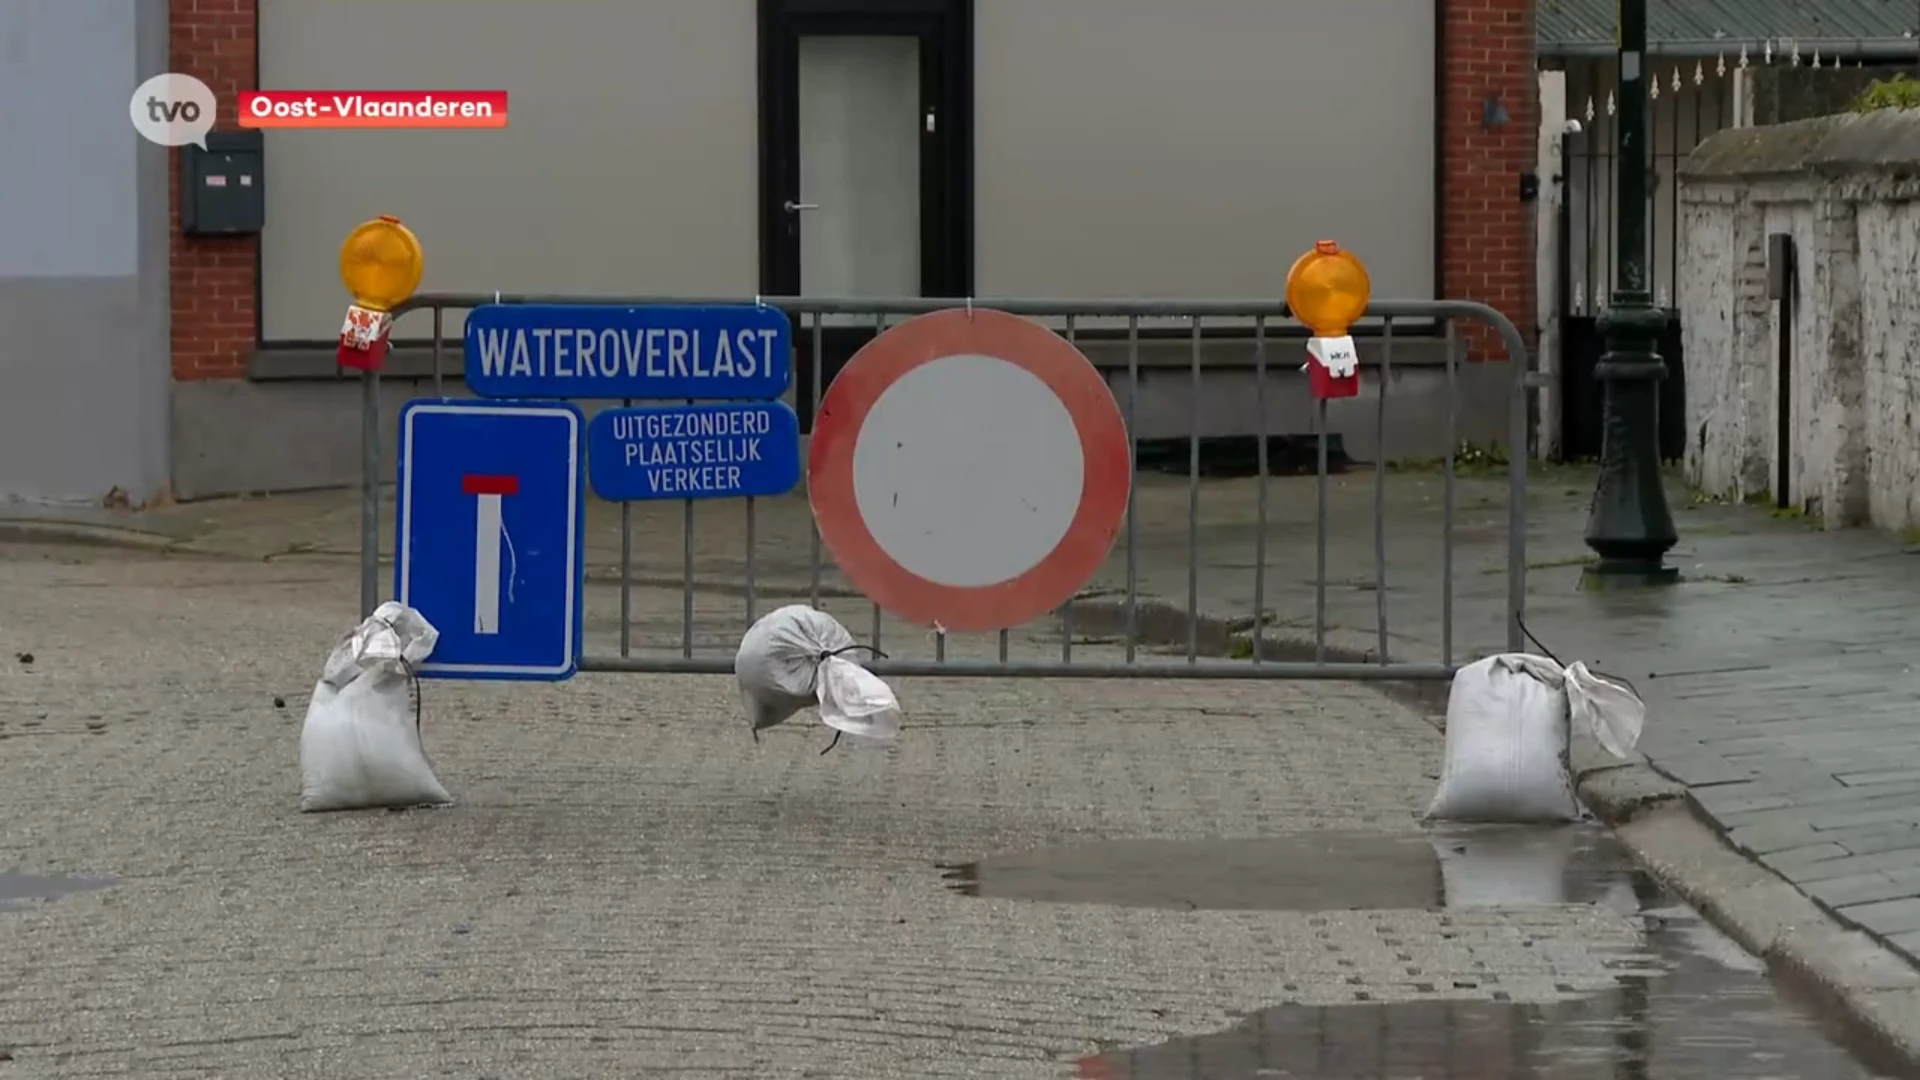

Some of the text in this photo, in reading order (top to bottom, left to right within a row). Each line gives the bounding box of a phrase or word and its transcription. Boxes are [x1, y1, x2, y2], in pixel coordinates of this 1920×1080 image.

[477, 328, 778, 378] WATEROVERLAST
[613, 411, 770, 440] UITGEZONDERD
[626, 439, 762, 466] PLAATSELIJK
[647, 467, 741, 493] VERKEER
